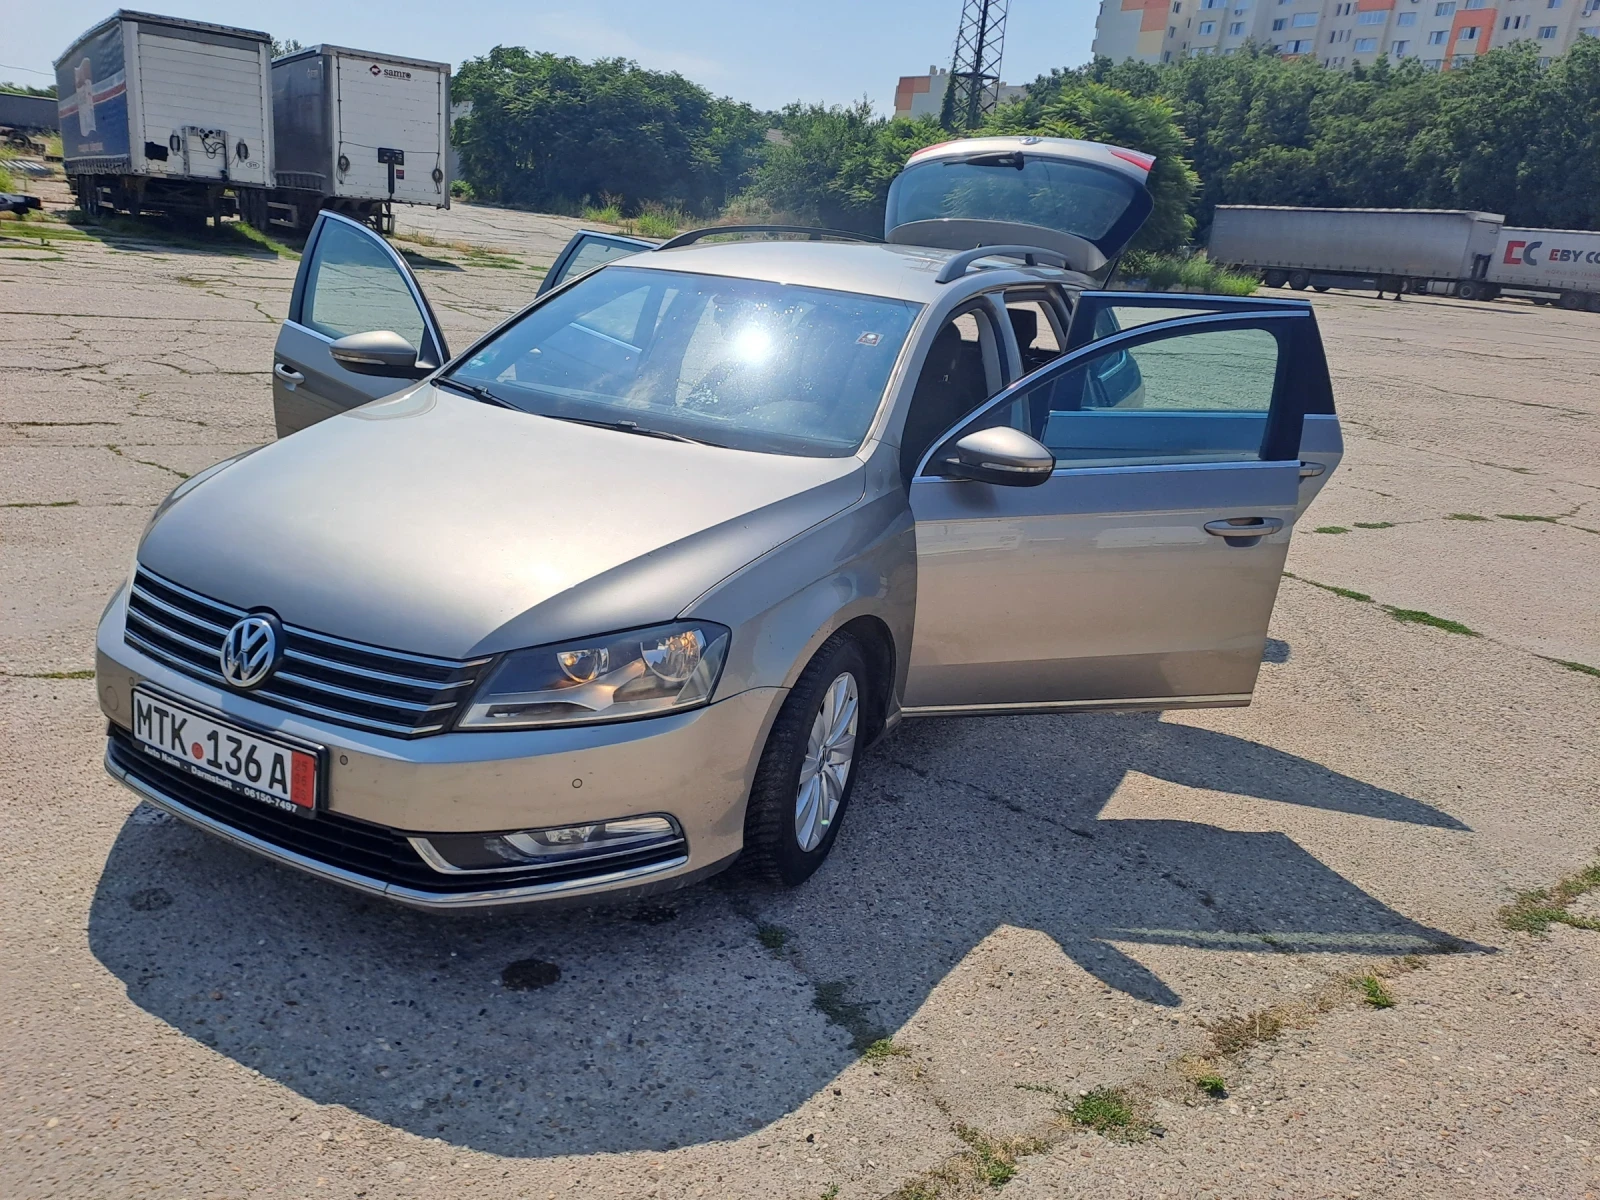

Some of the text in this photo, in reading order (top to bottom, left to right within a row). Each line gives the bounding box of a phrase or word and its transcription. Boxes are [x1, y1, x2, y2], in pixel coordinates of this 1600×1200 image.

[383, 68, 412, 79] samro
[1549, 248, 1584, 263] EBY
[136, 697, 188, 757] MTK
[143, 744, 161, 759] Auto
[190, 764, 233, 790] Darmstadt
[243, 786, 298, 813] 06150-7497
